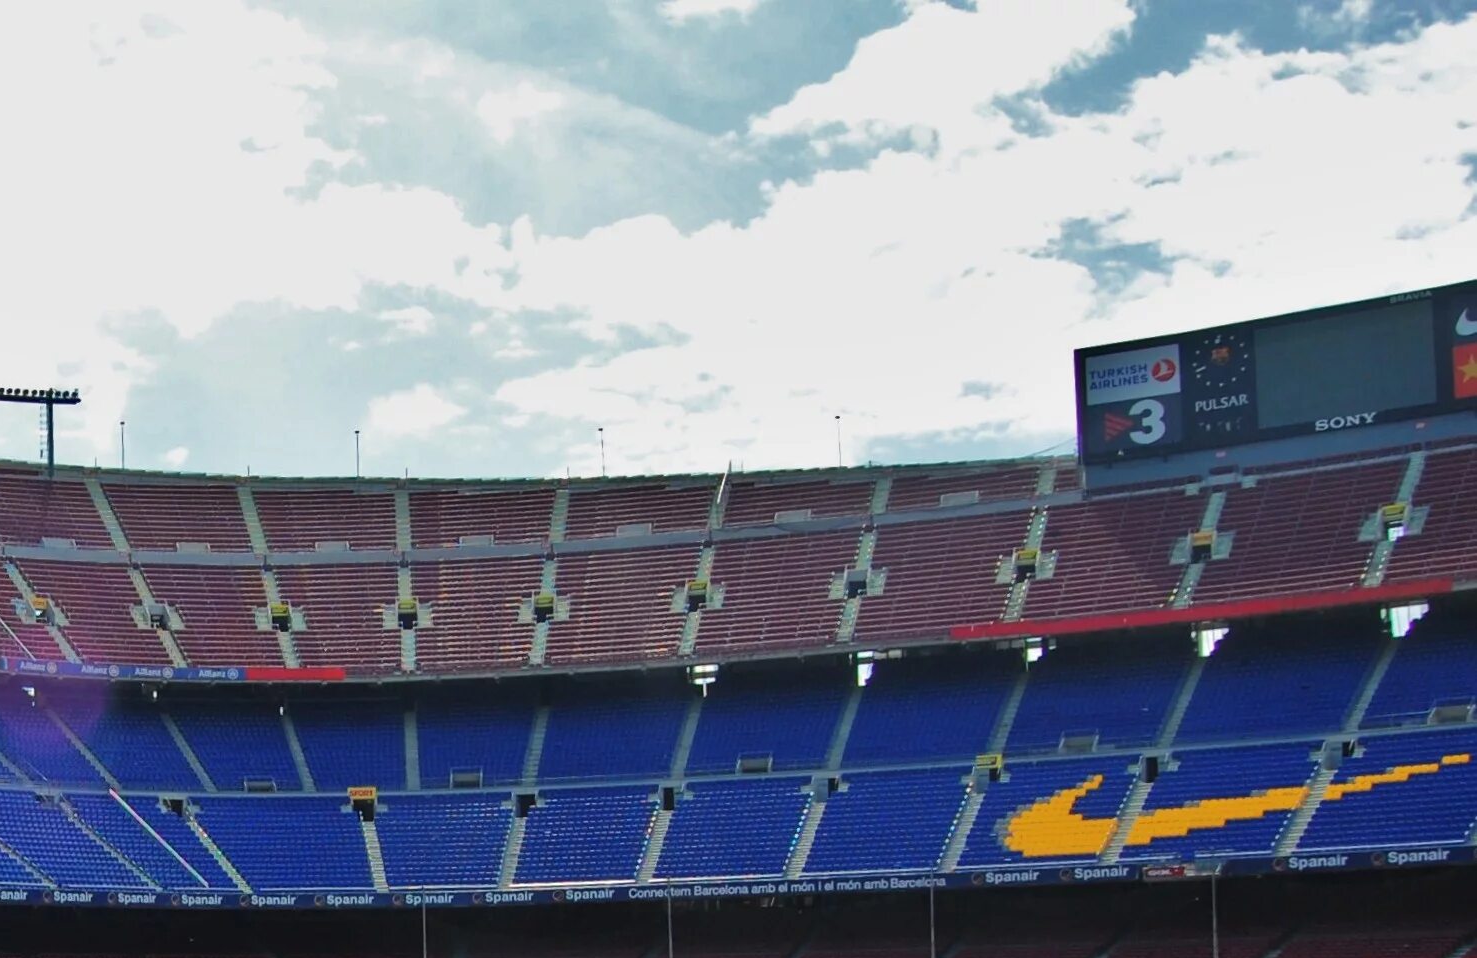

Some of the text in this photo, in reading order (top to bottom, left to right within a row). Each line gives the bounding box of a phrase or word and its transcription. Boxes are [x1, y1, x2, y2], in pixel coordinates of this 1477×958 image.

[1088, 363, 1148, 381] TURKISH
[1089, 374, 1148, 391] AIRLINES
[1194, 393, 1249, 413] PULSAR
[1129, 399, 1165, 445] 3
[1314, 411, 1378, 432] SONY
[20, 661, 46, 672] Allianz
[81, 665, 108, 676] Allianz
[135, 667, 161, 678] Allianz
[199, 669, 226, 678] Allianz
[1288, 854, 1348, 870] Spanair
[1387, 849, 1450, 864] Spanair
[985, 870, 1040, 885] Spanair
[1074, 865, 1129, 880] Spanair
[628, 885, 690, 899] Connectem
[694, 884, 749, 896] Barcelona
[751, 881, 776, 894] amb
[778, 882, 788, 893] el
[791, 880, 816, 892] món
[824, 881, 834, 891] el
[836, 879, 862, 891] món
[864, 878, 889, 890] amb
[890, 876, 946, 889] Barcelona
[53, 891, 93, 904] Spanair
[118, 893, 156, 905] Spanair
[181, 894, 222, 907] Spanair
[251, 895, 296, 908] Spanair
[326, 894, 374, 908] Spanair
[405, 893, 454, 907] Spanair
[485, 891, 534, 904] Spanair
[566, 888, 615, 902] Spanair
